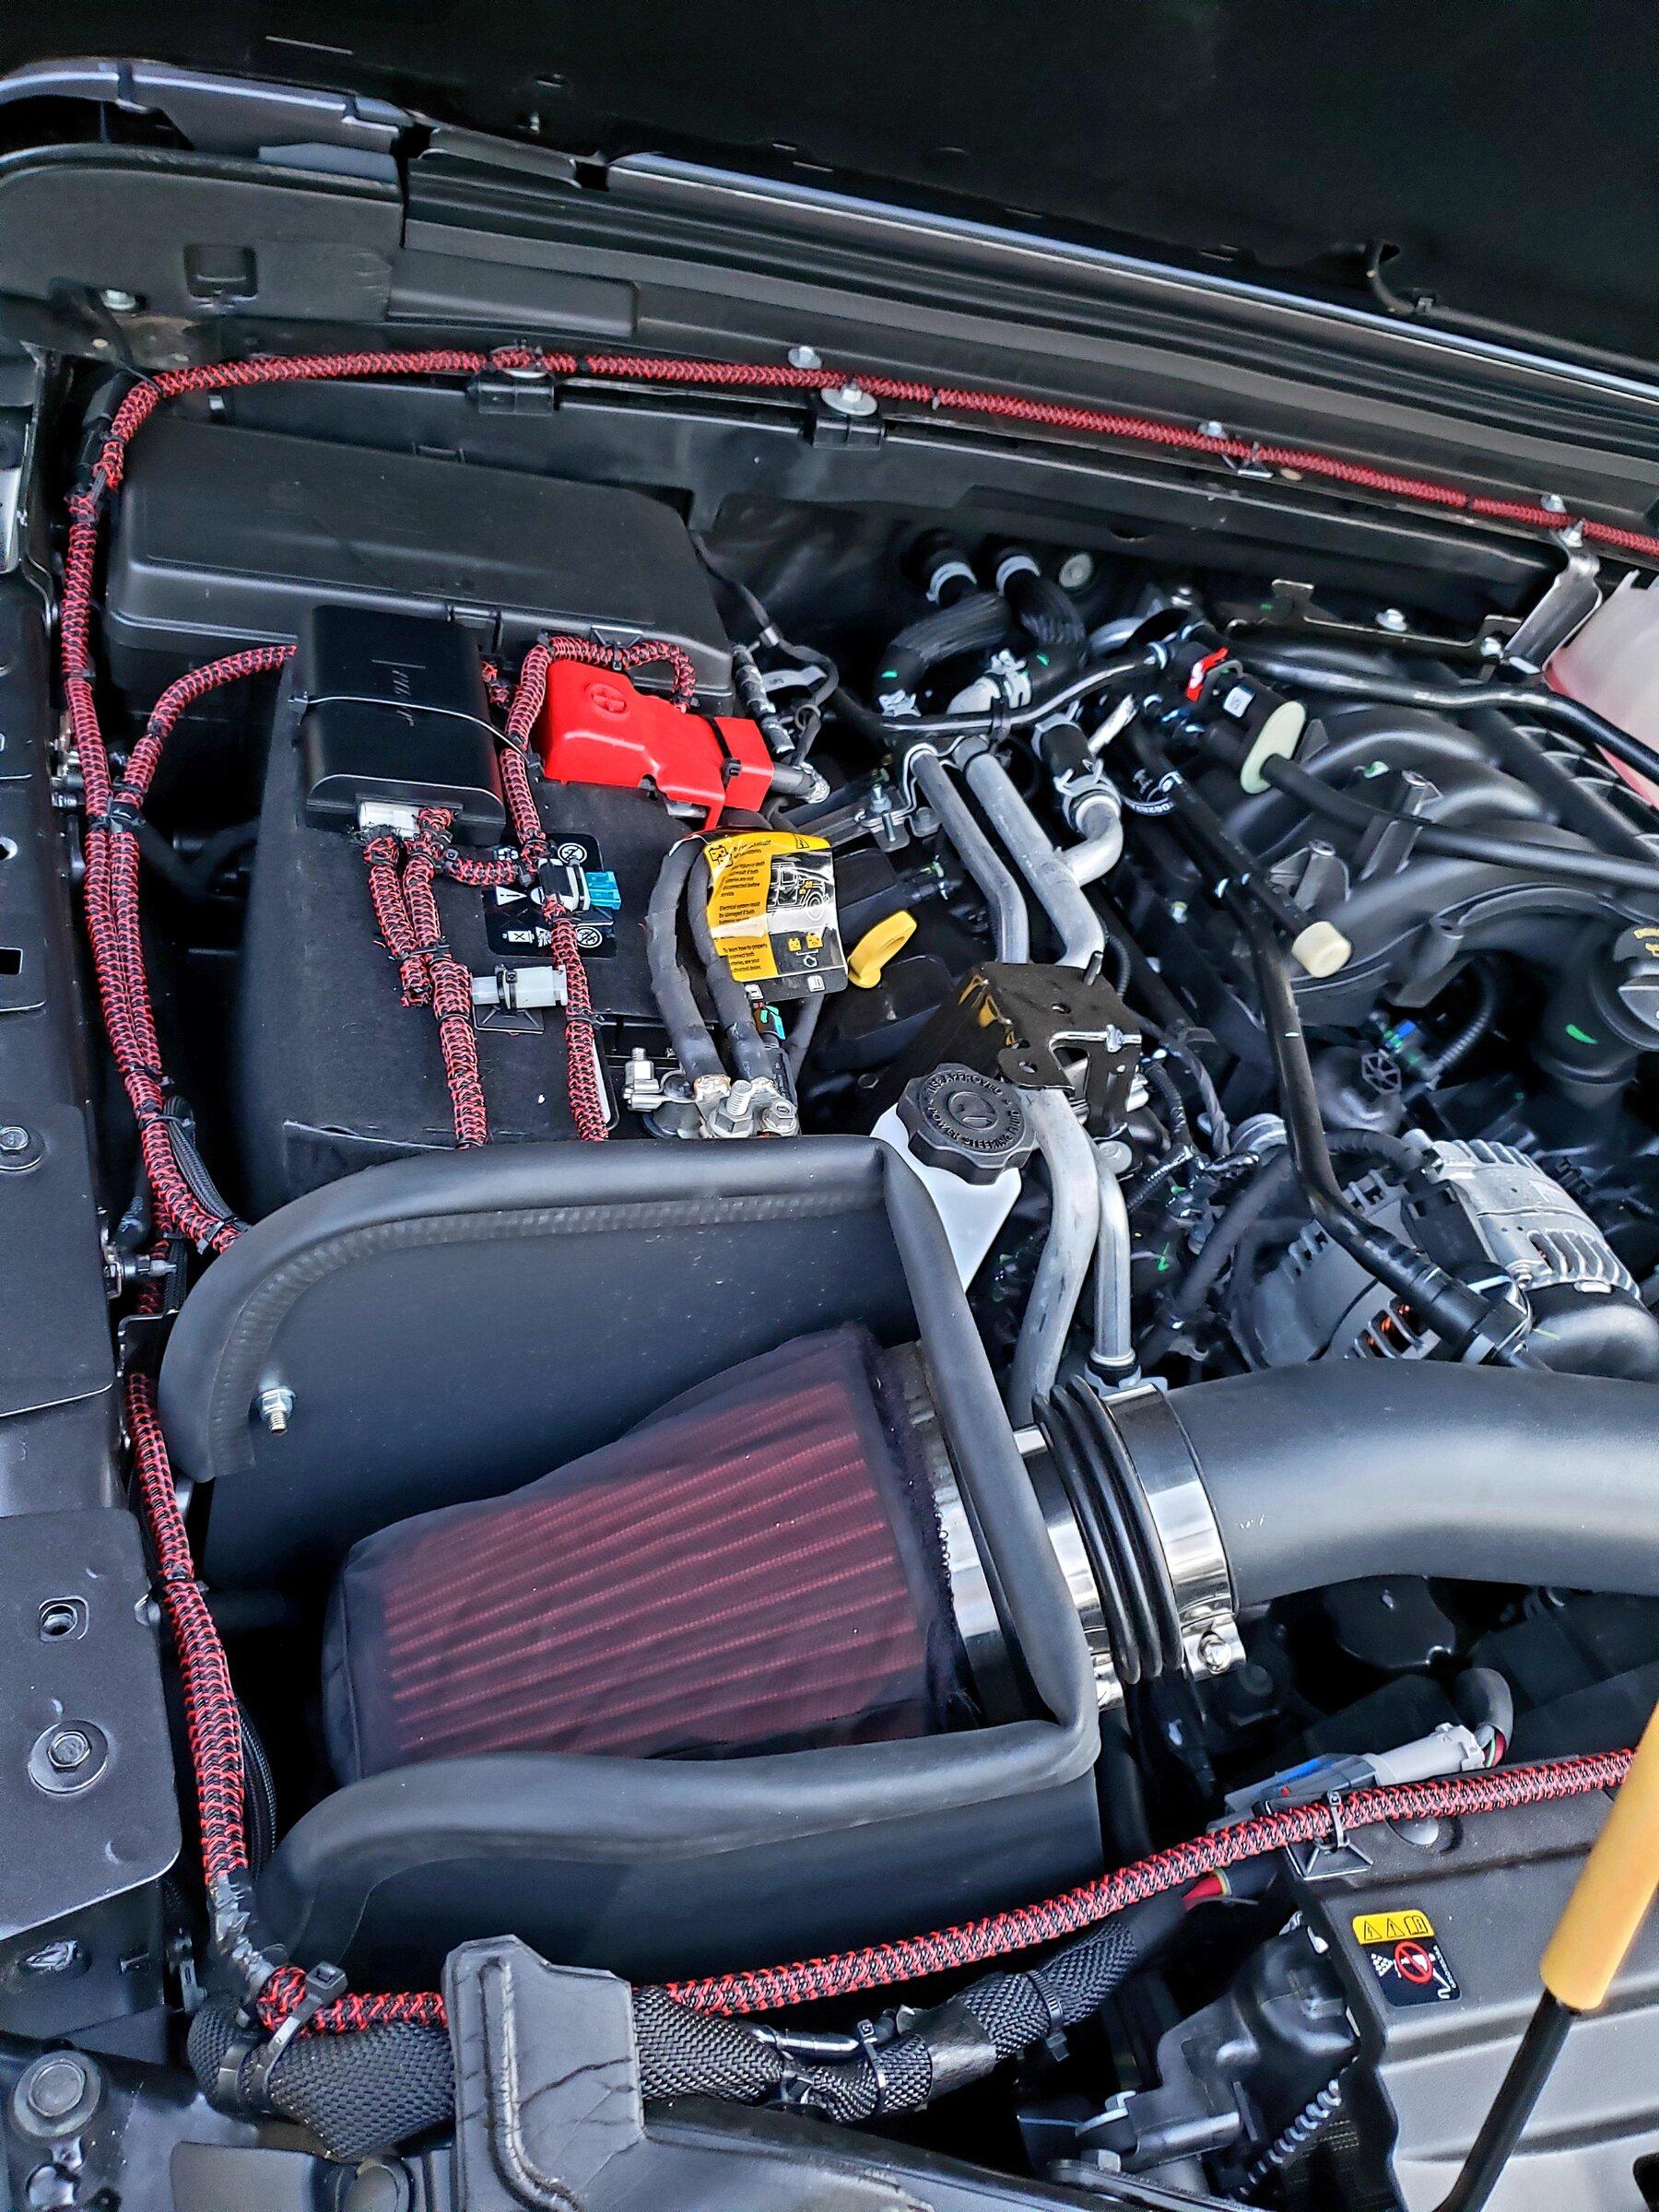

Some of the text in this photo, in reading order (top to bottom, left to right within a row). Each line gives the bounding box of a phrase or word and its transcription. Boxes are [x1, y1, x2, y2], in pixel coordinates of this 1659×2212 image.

[942, 1072, 1003, 1095] APPROVED
[927, 1106, 1020, 1149] POWER STEERING FLUID
